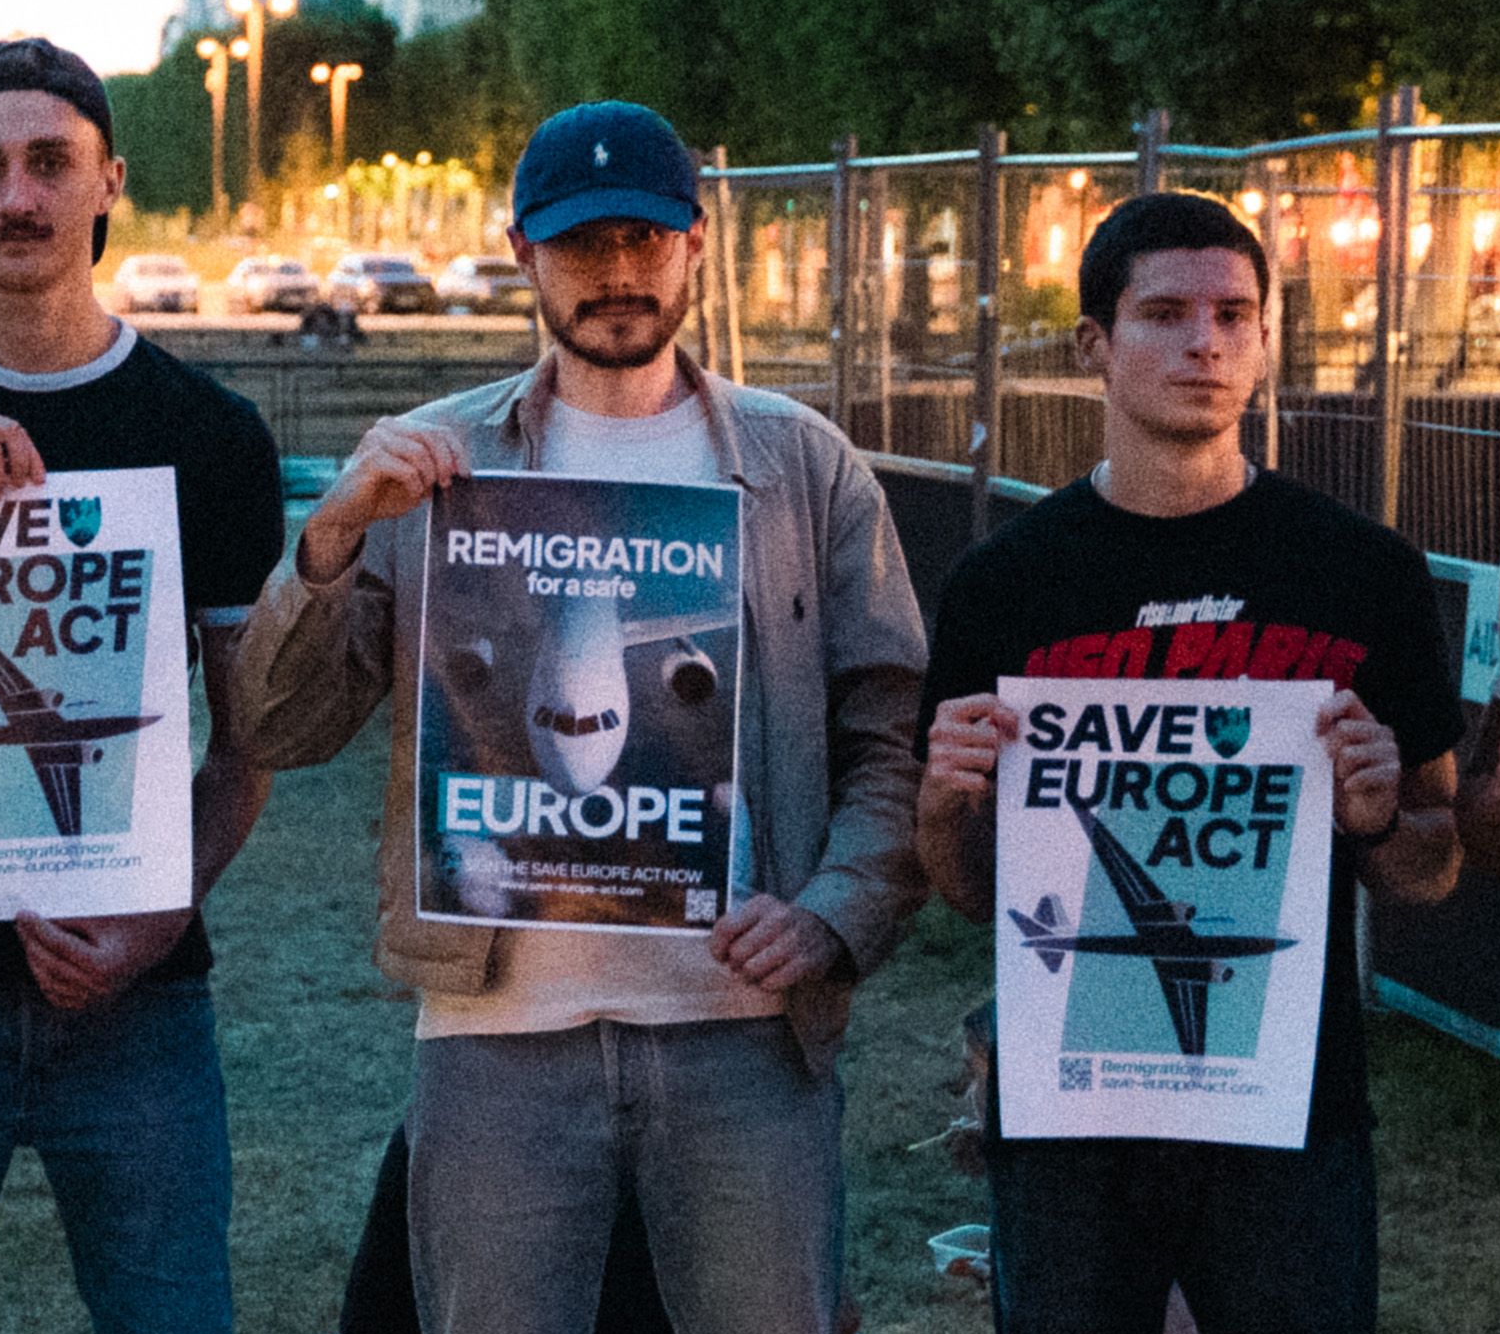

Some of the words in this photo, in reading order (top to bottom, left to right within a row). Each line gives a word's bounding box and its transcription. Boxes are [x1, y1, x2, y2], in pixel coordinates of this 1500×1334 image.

[447, 529, 723, 580] REMIGRATION
[527, 571, 561, 595] for
[564, 578, 580, 597] a
[583, 574, 637, 599] safe
[12, 603, 141, 658] ACT
[1026, 703, 1198, 754] SAVE
[445, 777, 705, 843] EUROPE
[1025, 758, 1294, 814] EUROPE
[1145, 817, 1285, 869] ACT
[502, 860, 529, 875] THE
[531, 862, 567, 878] SAVE
[570, 864, 630, 881] EUROPE
[632, 867, 661, 882] ACT
[664, 869, 703, 884] NOW
